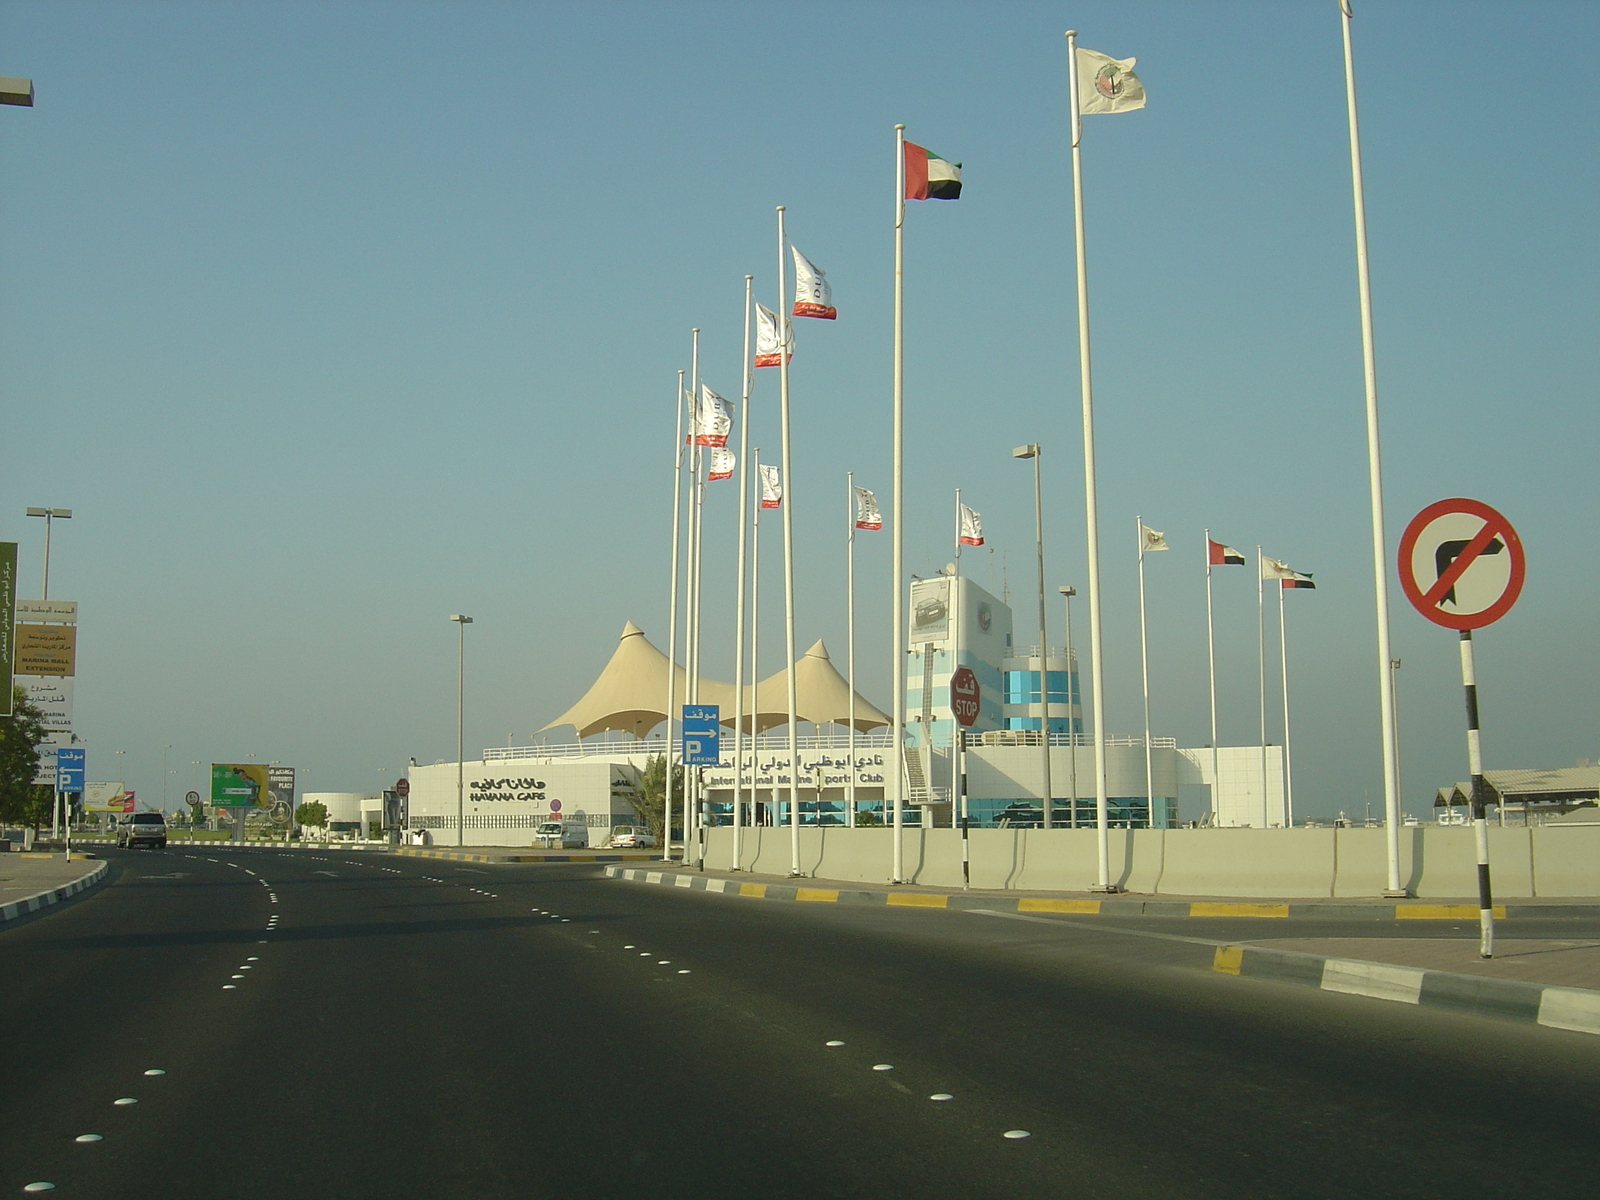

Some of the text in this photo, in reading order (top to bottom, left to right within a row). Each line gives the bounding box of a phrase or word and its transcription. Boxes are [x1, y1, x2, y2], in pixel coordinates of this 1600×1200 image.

[956, 674, 975, 695] قف
[955, 700, 978, 716] STOP
[685, 709, 717, 721] موقف
[59, 752, 84, 760] موقف
[854, 753, 883, 771] نادي
[777, 775, 813, 784] Maine
[859, 773, 884, 783] Club
[470, 792, 515, 801] HAVANA
